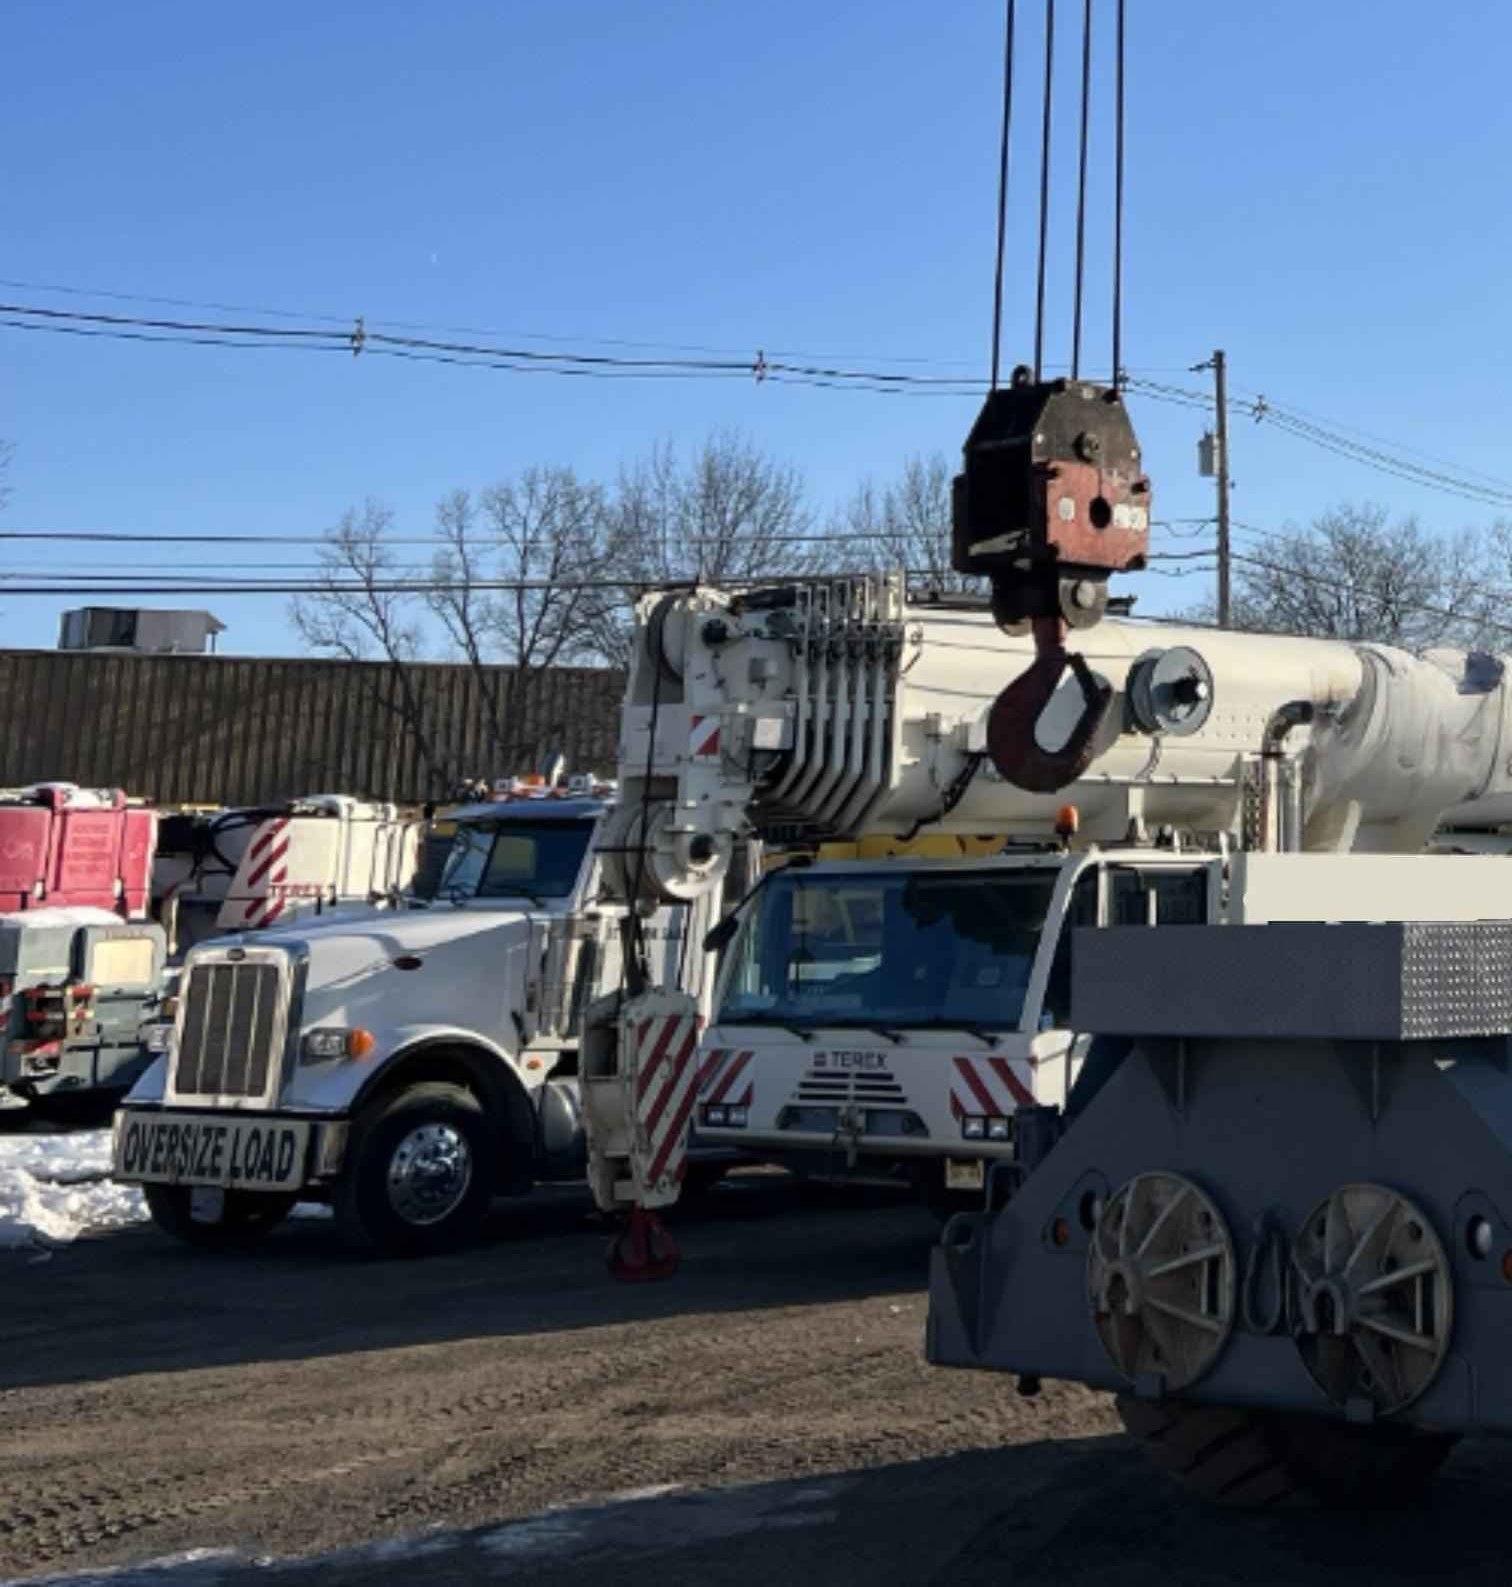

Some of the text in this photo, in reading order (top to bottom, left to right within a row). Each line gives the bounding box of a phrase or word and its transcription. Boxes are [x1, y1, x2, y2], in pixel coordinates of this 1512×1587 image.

[831, 1050, 887, 1070] TEREX
[123, 1121, 295, 1182] OVERSIZE LOAD
